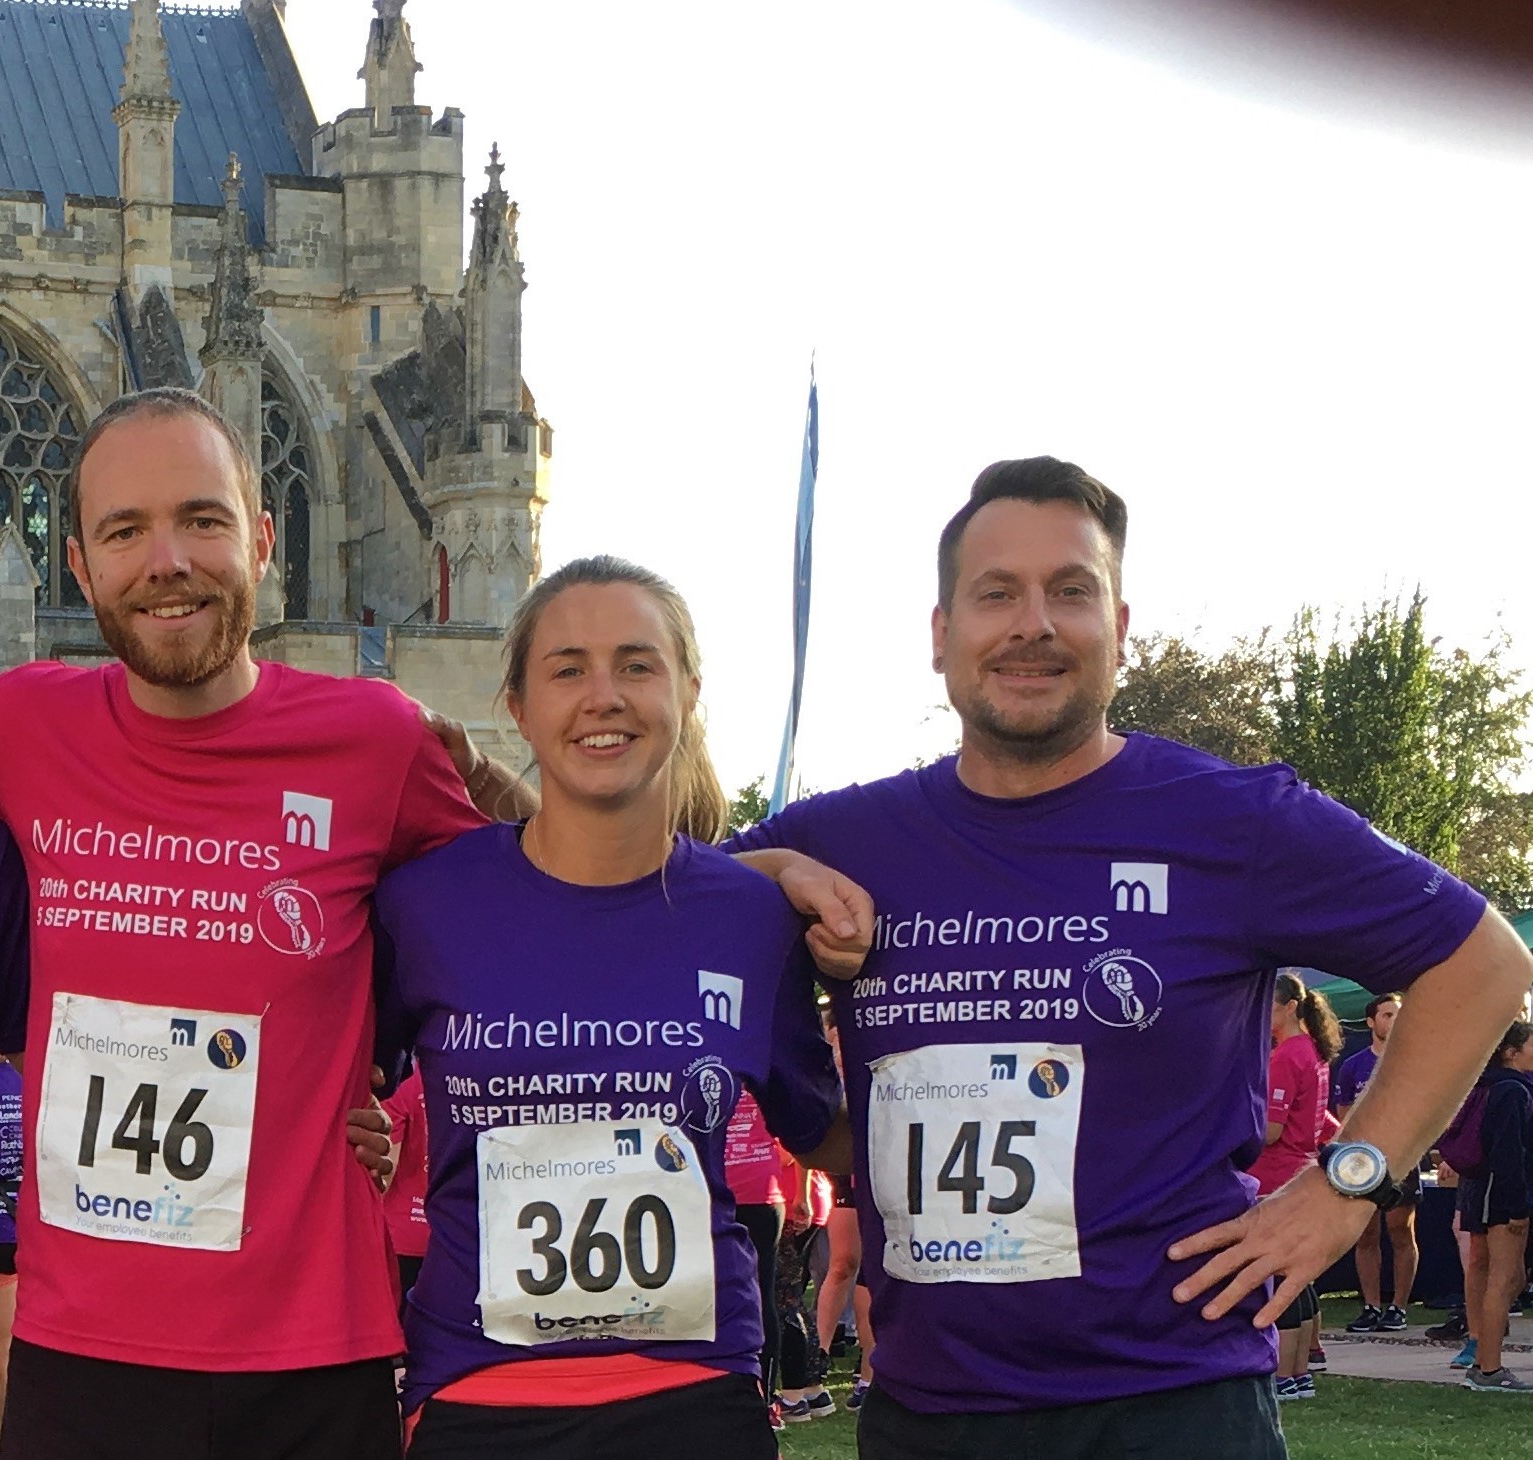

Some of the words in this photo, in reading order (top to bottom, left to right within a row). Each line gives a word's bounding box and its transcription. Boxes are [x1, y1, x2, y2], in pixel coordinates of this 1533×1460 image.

[32, 818, 281, 871] Michelmores
[39, 877, 68, 899] 20th
[73, 879, 185, 908] CHARITY
[191, 889, 247, 913] RUN
[36, 906, 43, 926] 5
[44, 907, 187, 938] SEPTEMBER
[196, 919, 254, 944] 2019
[1082, 947, 1132, 973] Celebrating
[852, 976, 886, 999] 20th
[893, 969, 1007, 994] CHARITY
[1013, 968, 1072, 990] RUN
[855, 1008, 863, 1029] 5
[864, 999, 1012, 1027] SEPTEMBER
[1019, 998, 1079, 1020] 2019
[55, 1027, 168, 1062] Michelmores
[442, 1012, 704, 1051] Michelmores
[446, 1075, 480, 1097] 20th
[488, 1072, 608, 1097] CHARITY
[615, 1071, 672, 1093] RUN
[876, 1082, 989, 1102] Michelmores
[77, 1074, 214, 1182] 146
[451, 1104, 460, 1124] 5
[462, 1102, 612, 1126] SEPTEMBER
[621, 1102, 677, 1124] 2019
[486, 1160, 616, 1181] Michelmores
[907, 1120, 1037, 1215] 145
[75, 1184, 194, 1227] benefiz
[96, 1220, 147, 1237] employee
[149, 1227, 193, 1242] benefits
[516, 1194, 676, 1297] 360
[909, 1229, 1027, 1263] benefiz
[933, 1266, 982, 1277] employee
[984, 1265, 1028, 1275] benefits
